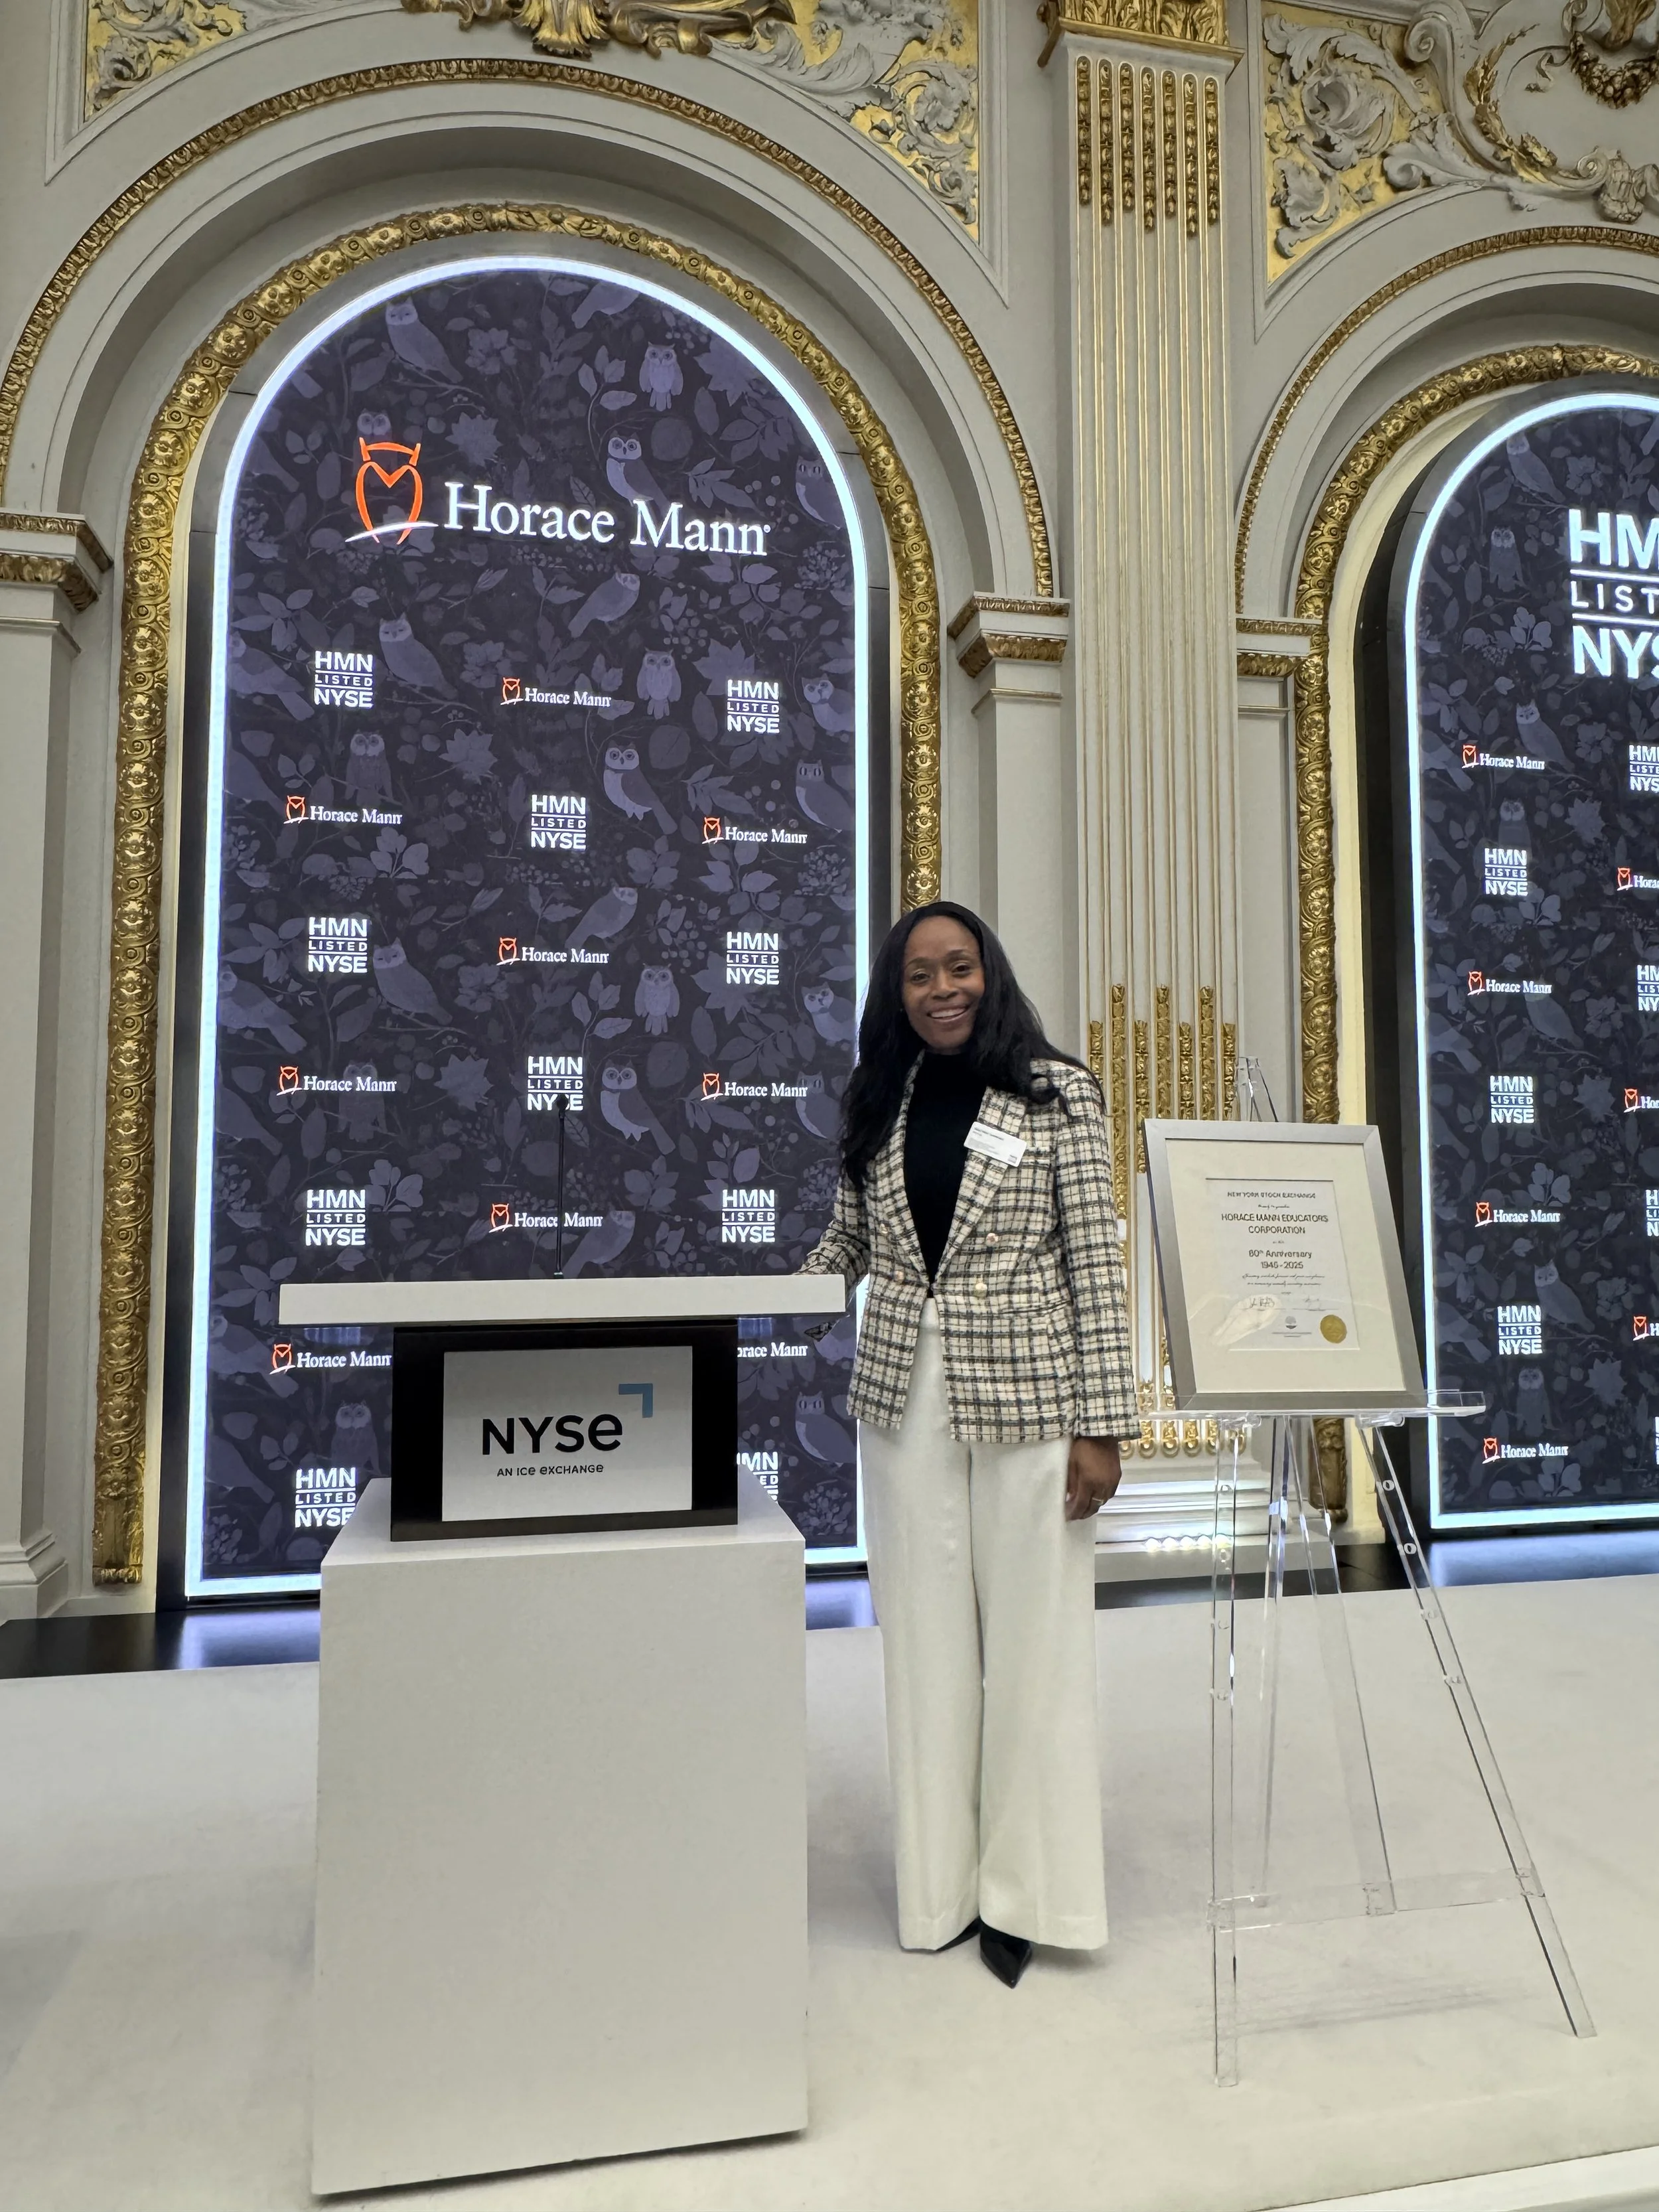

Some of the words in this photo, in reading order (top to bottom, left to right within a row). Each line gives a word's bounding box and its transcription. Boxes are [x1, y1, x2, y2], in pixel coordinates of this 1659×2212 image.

[443, 481, 615, 543] Horace
[1568, 508, 1659, 570] HM
[1570, 580, 1659, 615] LIST
[315, 650, 373, 673] HMN
[314, 674, 373, 687] LISTED
[314, 687, 374, 709] NYSE
[524, 687, 570, 705] Horace
[573, 690, 612, 707] Mann
[727, 679, 779, 700] HMN
[727, 701, 780, 713] LISTED
[727, 714, 780, 734] NYSE
[1479, 753, 1514, 768] Horace
[531, 794, 586, 815] HMN
[309, 805, 358, 823] Horace
[362, 808, 403, 825] Mann
[531, 817, 587, 829] LISTED
[530, 830, 587, 850] NYSE
[725, 826, 768, 842] Horace
[770, 828, 808, 844] Mann
[1484, 848, 1528, 866] HMN
[1484, 867, 1528, 878] LISTED
[1484, 879, 1529, 897] NYSE
[308, 917, 368, 937] HMN
[308, 940, 368, 952] LISTED
[726, 931, 779, 951] HMN
[521, 946, 567, 963] Horace
[570, 948, 610, 964] Mann
[726, 953, 779, 964] LISTED
[307, 954, 368, 974] NYSE
[726, 967, 780, 986] NYSE
[1485, 978, 1521, 993] Horace
[528, 1055, 583, 1075] HMN
[301, 1075, 353, 1092] Horace
[355, 1076, 397, 1092] Mann
[527, 1078, 583, 1090] LISTED
[722, 1082, 768, 1097] Horace
[770, 1082, 808, 1097] Mann
[1490, 1075, 1534, 1092] HMN
[1490, 1095, 1534, 1105] LISTED
[1490, 1108, 1535, 1124] NYSE
[306, 1189, 366, 1209] HMN
[722, 1189, 775, 1208] HMN
[306, 1213, 366, 1224] LISTED
[514, 1212, 558, 1228] Horace
[563, 1212, 603, 1227] Mann
[721, 1212, 775, 1222] LISTED
[1221, 1213, 1255, 1222] HORACE
[1281, 1214, 1329, 1222] EDUCATORS
[1493, 1209, 1529, 1223] Horace
[305, 1228, 366, 1246] NYSE
[721, 1225, 776, 1244] NYSE
[1248, 1225, 1305, 1234] CORPORATION
[1497, 1305, 1542, 1323] HMN
[1498, 1325, 1542, 1336] LISTED
[1498, 1338, 1543, 1355] NYSE
[297, 1352, 347, 1368] Horace
[349, 1351, 392, 1367] Mann
[1500, 1444, 1537, 1459] Horace
[295, 1467, 356, 1489] HMN
[497, 1467, 513, 1477] AN
[295, 1492, 356, 1504] LISTED
